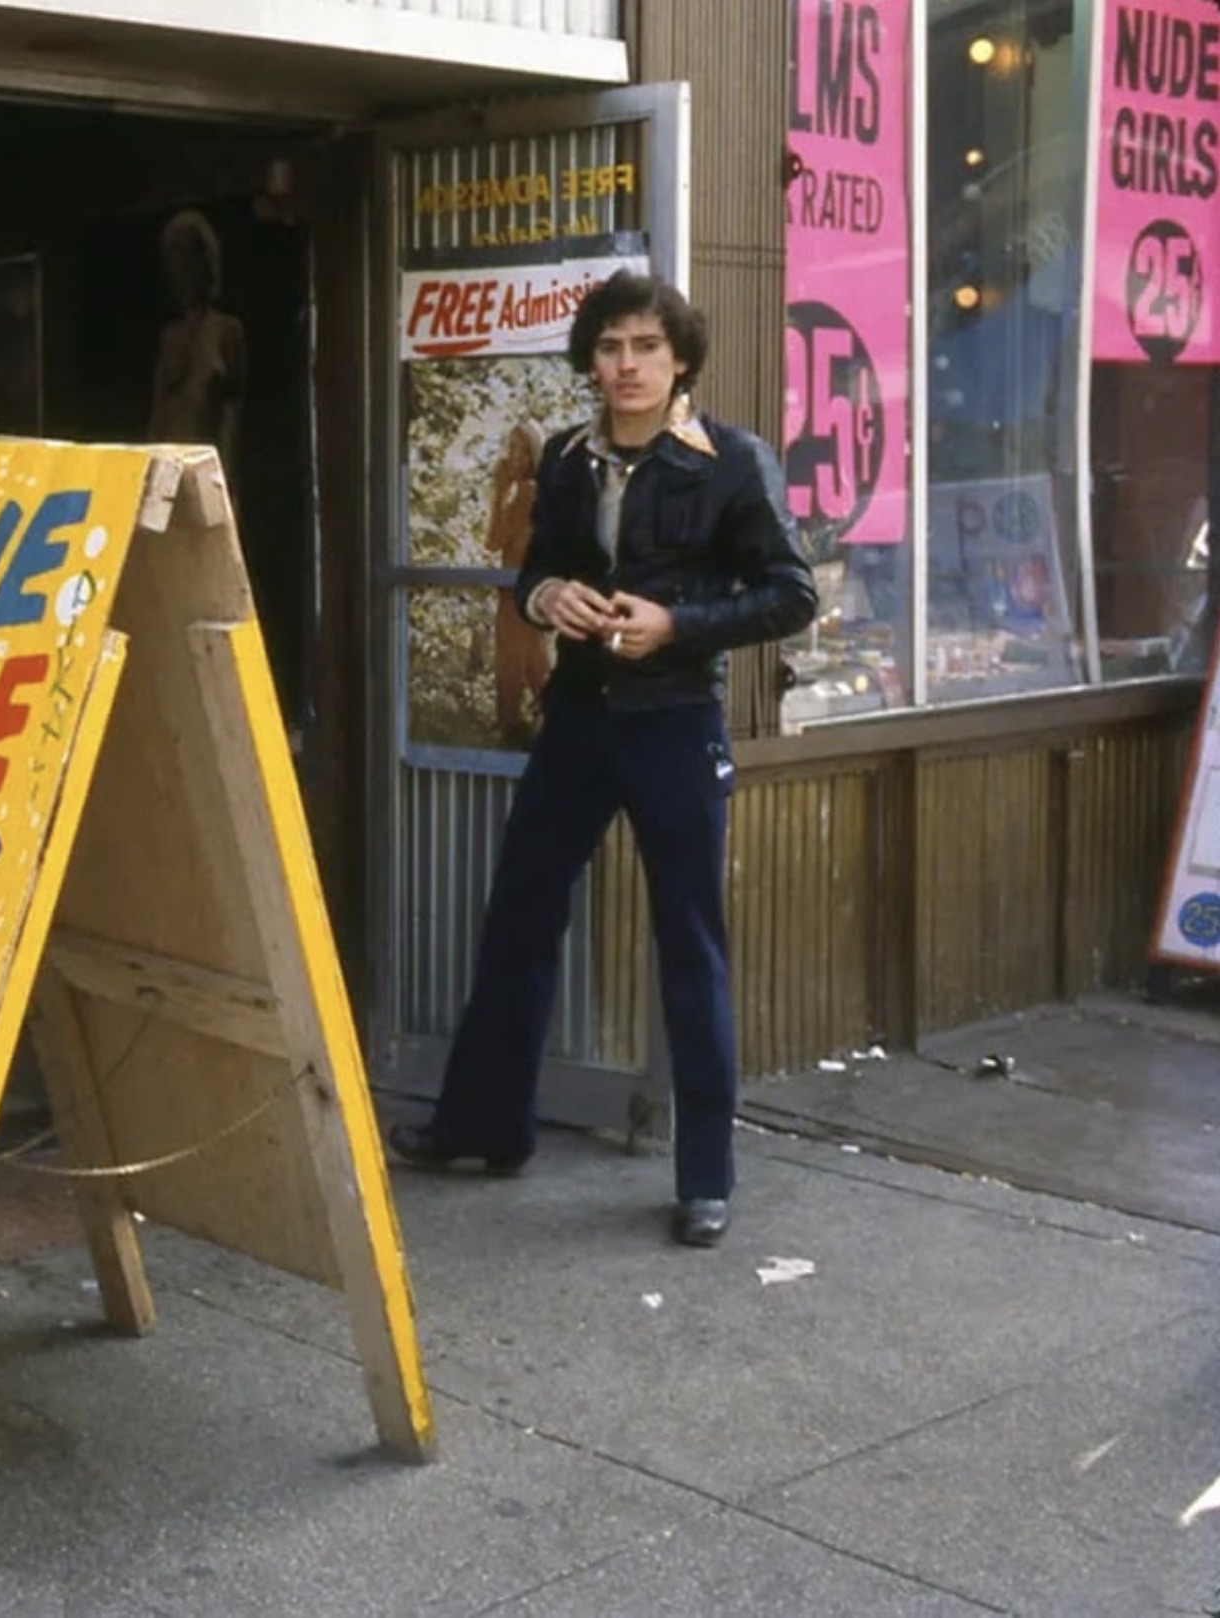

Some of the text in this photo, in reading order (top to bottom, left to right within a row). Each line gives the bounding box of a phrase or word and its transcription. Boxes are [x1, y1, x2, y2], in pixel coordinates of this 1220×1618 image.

[1114, 6, 1220, 102] NUDE
[1111, 107, 1218, 198] GIRLS
[407, 281, 498, 337] FREE
